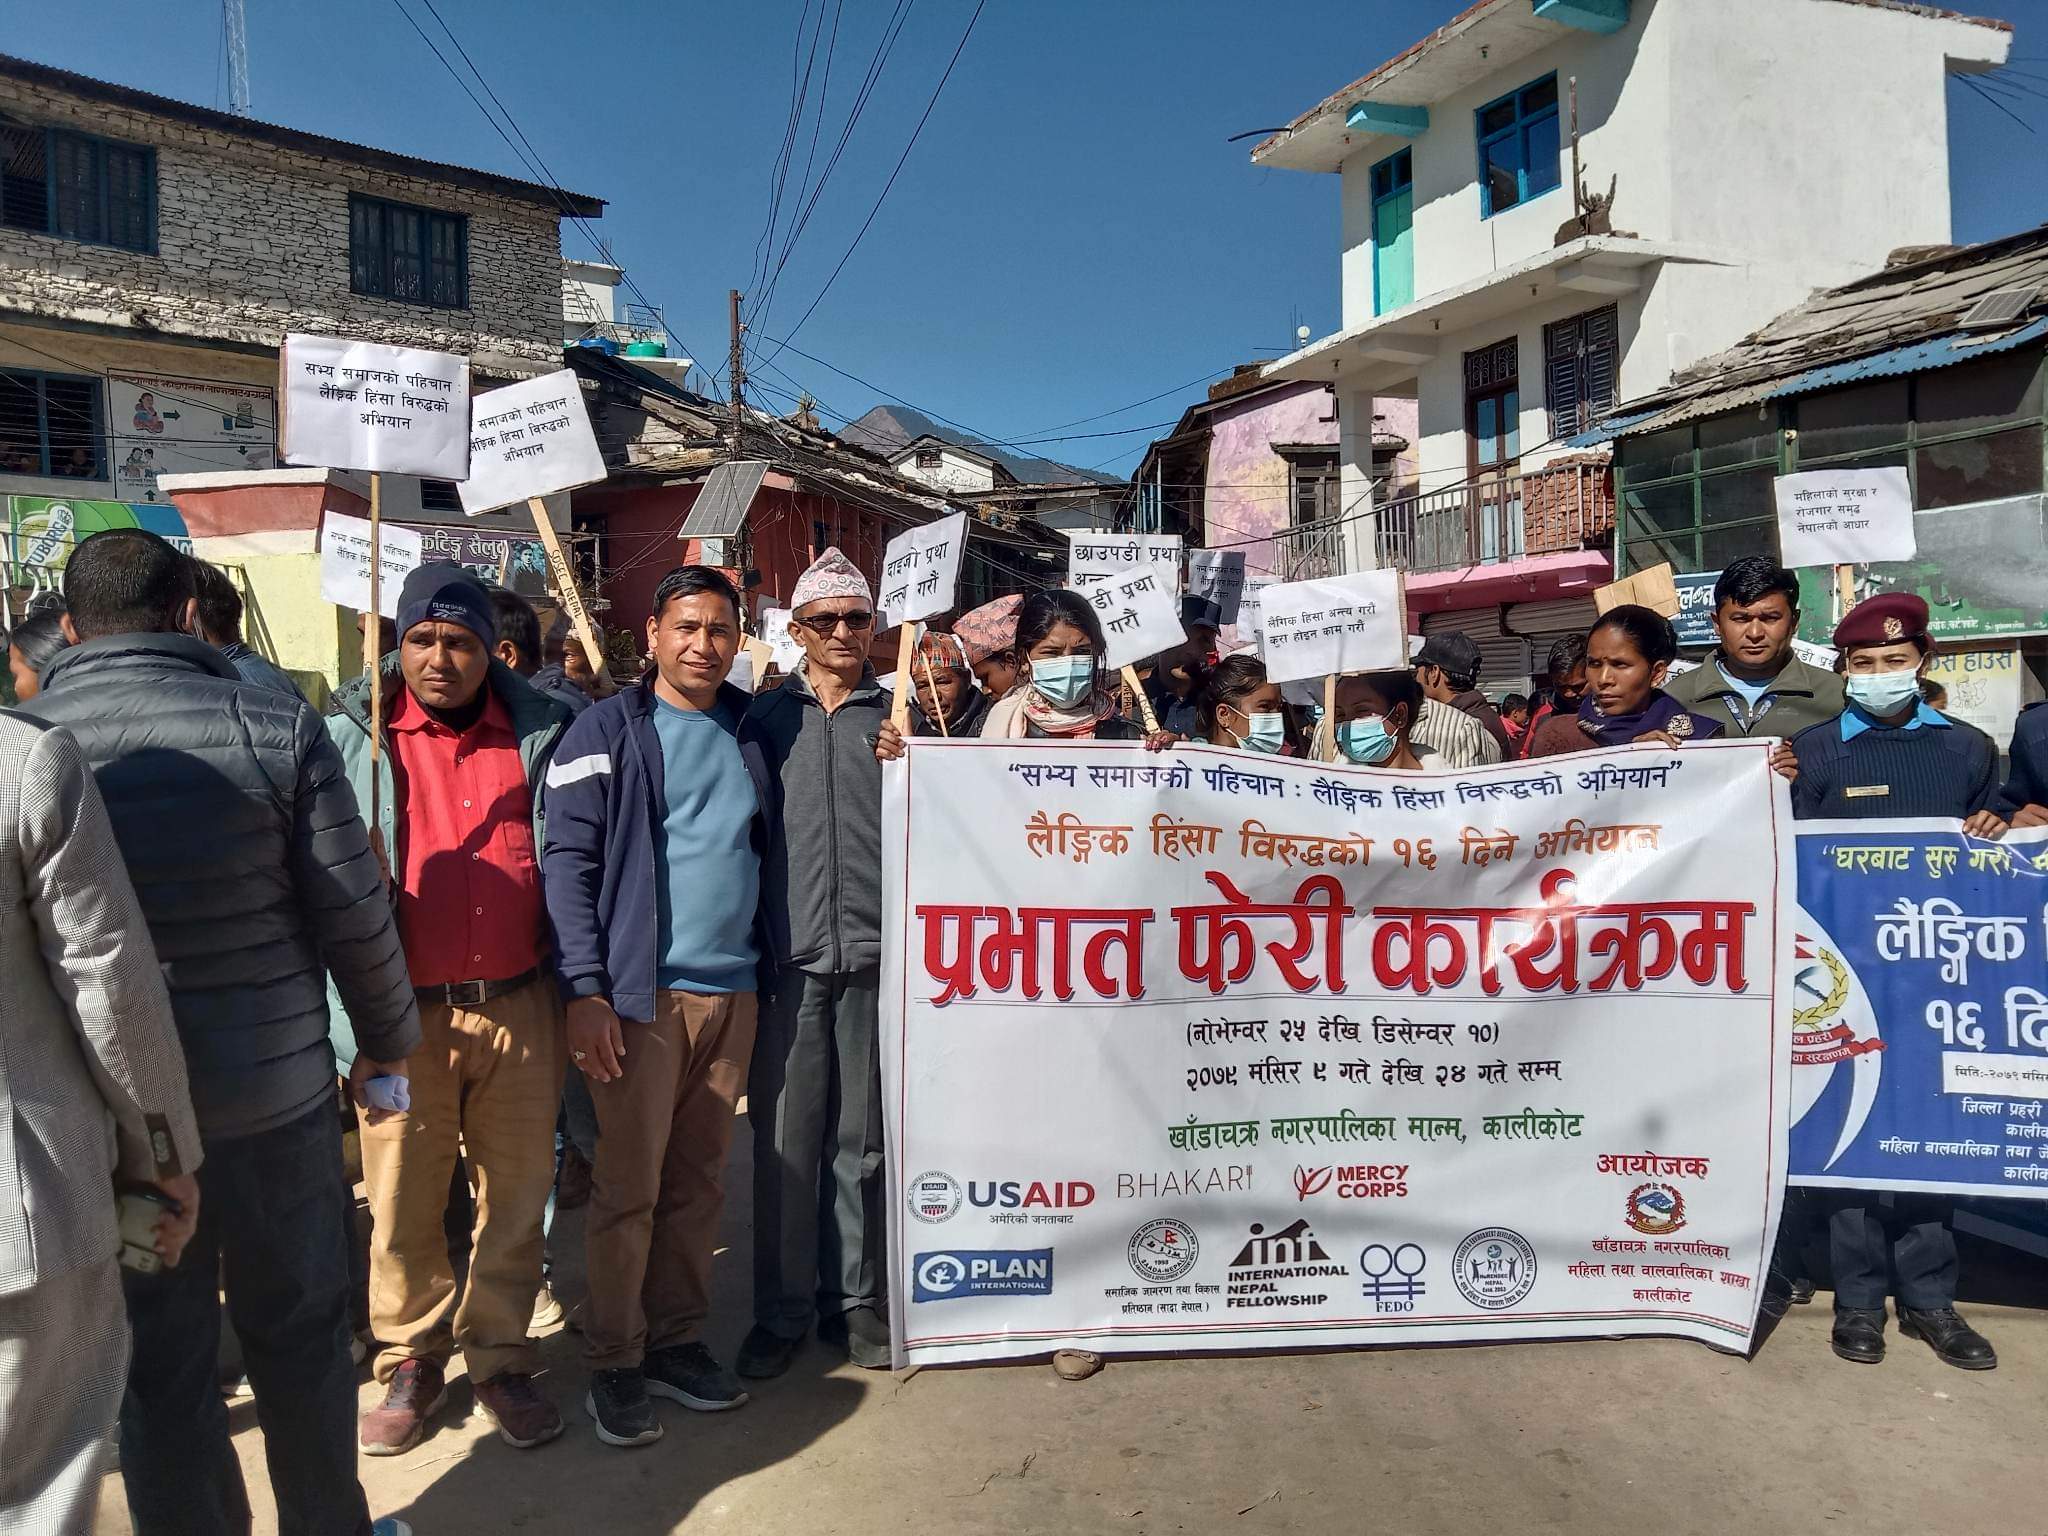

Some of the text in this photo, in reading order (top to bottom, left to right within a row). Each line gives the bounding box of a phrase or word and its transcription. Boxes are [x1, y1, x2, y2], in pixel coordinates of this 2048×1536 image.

[305, 362, 335, 378] सभ्य
[342, 367, 400, 385] समाजको
[405, 374, 452, 393] पहिचान
[360, 410, 412, 430] अभियान
[477, 407, 523, 430] समाजको
[527, 397, 569, 416] पहिचान
[503, 443, 545, 463] अभियान
[22, 520, 68, 569] TUBORG
[926, 541, 949, 565] प्रथा
[1074, 541, 1180, 562] छाउपडी प्रथा
[1120, 575, 1155, 600] प्रथा
[563, 586, 582, 618] NEPAL
[1322, 624, 1342, 636] काम
[1122, 685, 1132, 713] NEPAL
[1086, 760, 1192, 790] समाजको
[1201, 763, 1286, 798] पहिचान
[1391, 785, 1445, 811] हिंसा
[1149, 812, 1222, 863] हिंसा
[1239, 819, 1375, 868] विरुद्धको
[1393, 837, 1437, 871] १६
[1458, 826, 1520, 869] दिने
[1535, 818, 1663, 860] अभियान
[915, 868, 1758, 1007] प्रभात फेरी कार्यक्रम
[1874, 896, 2028, 985] लैङ्गिक
[1280, 1020, 1306, 1042] २५
[1318, 1015, 1362, 1043] देखि
[1925, 986, 2048, 1051] १६ दि
[1186, 1065, 1237, 1092] २०७९
[1248, 1055, 1302, 1084] मंसिर
[1338, 1058, 1371, 1085] गते
[1381, 1058, 1424, 1085] देखि
[1435, 1064, 1466, 1087] २४
[1477, 1059, 1508, 1084] गते
[1517, 1060, 1562, 1082] सम्म
[1960, 1096, 2043, 1119] जिल्ला प्रहरी
[1168, 1113, 1260, 1151] खाँडाचक्र
[1270, 1108, 1397, 1145] नगरपालिका
[1482, 1106, 1584, 1141] कालीकोट
[1879, 1136, 1919, 1155] महिला
[2005, 1144, 2033, 1158] तथा
[1337, 1164, 1409, 1182] MERCY
[1596, 1150, 1710, 1179] आयोजक
[968, 1181, 1095, 1208] USAID
[1337, 1182, 1409, 1199] CORPS
[1654, 1240, 1730, 1261] नगरपालिका
[970, 1258, 1047, 1279] PLAN
[1228, 1266, 1349, 1282] INTERNATIONAL
[1568, 1261, 1606, 1279] महिला
[1611, 1264, 1635, 1278] तथा
[970, 1281, 1047, 1290] INTERNATIONAL
[1227, 1281, 1278, 1296] NEPAL
[1633, 1287, 1692, 1303] कालीकोट
[1227, 1294, 1328, 1309] FELLOWSHIP
[1376, 1300, 1414, 1313] FEDO
